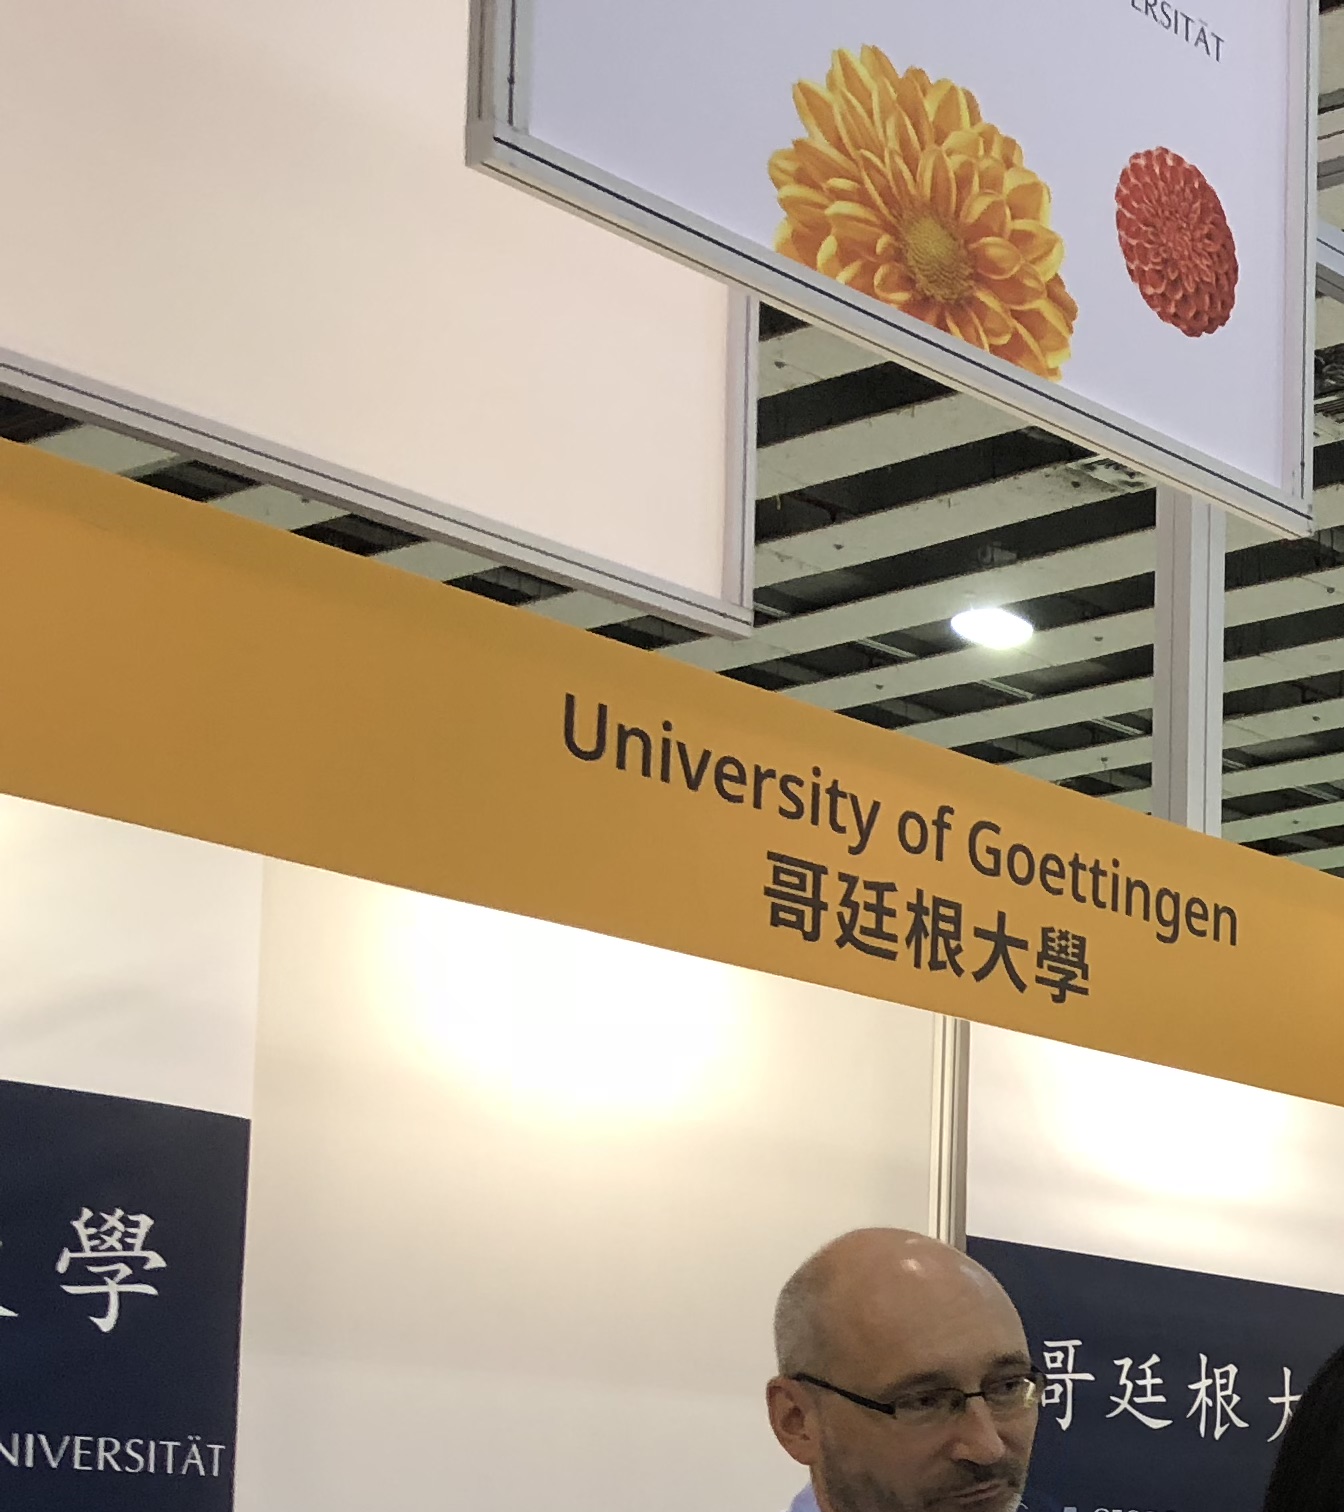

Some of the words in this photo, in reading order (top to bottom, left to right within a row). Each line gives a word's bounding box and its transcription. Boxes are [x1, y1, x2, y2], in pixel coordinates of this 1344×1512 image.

[562, 692, 881, 856] University
[897, 804, 955, 863] of
[967, 820, 1240, 947] Goettingen
[761, 849, 1092, 1004] 哥廷根大學
